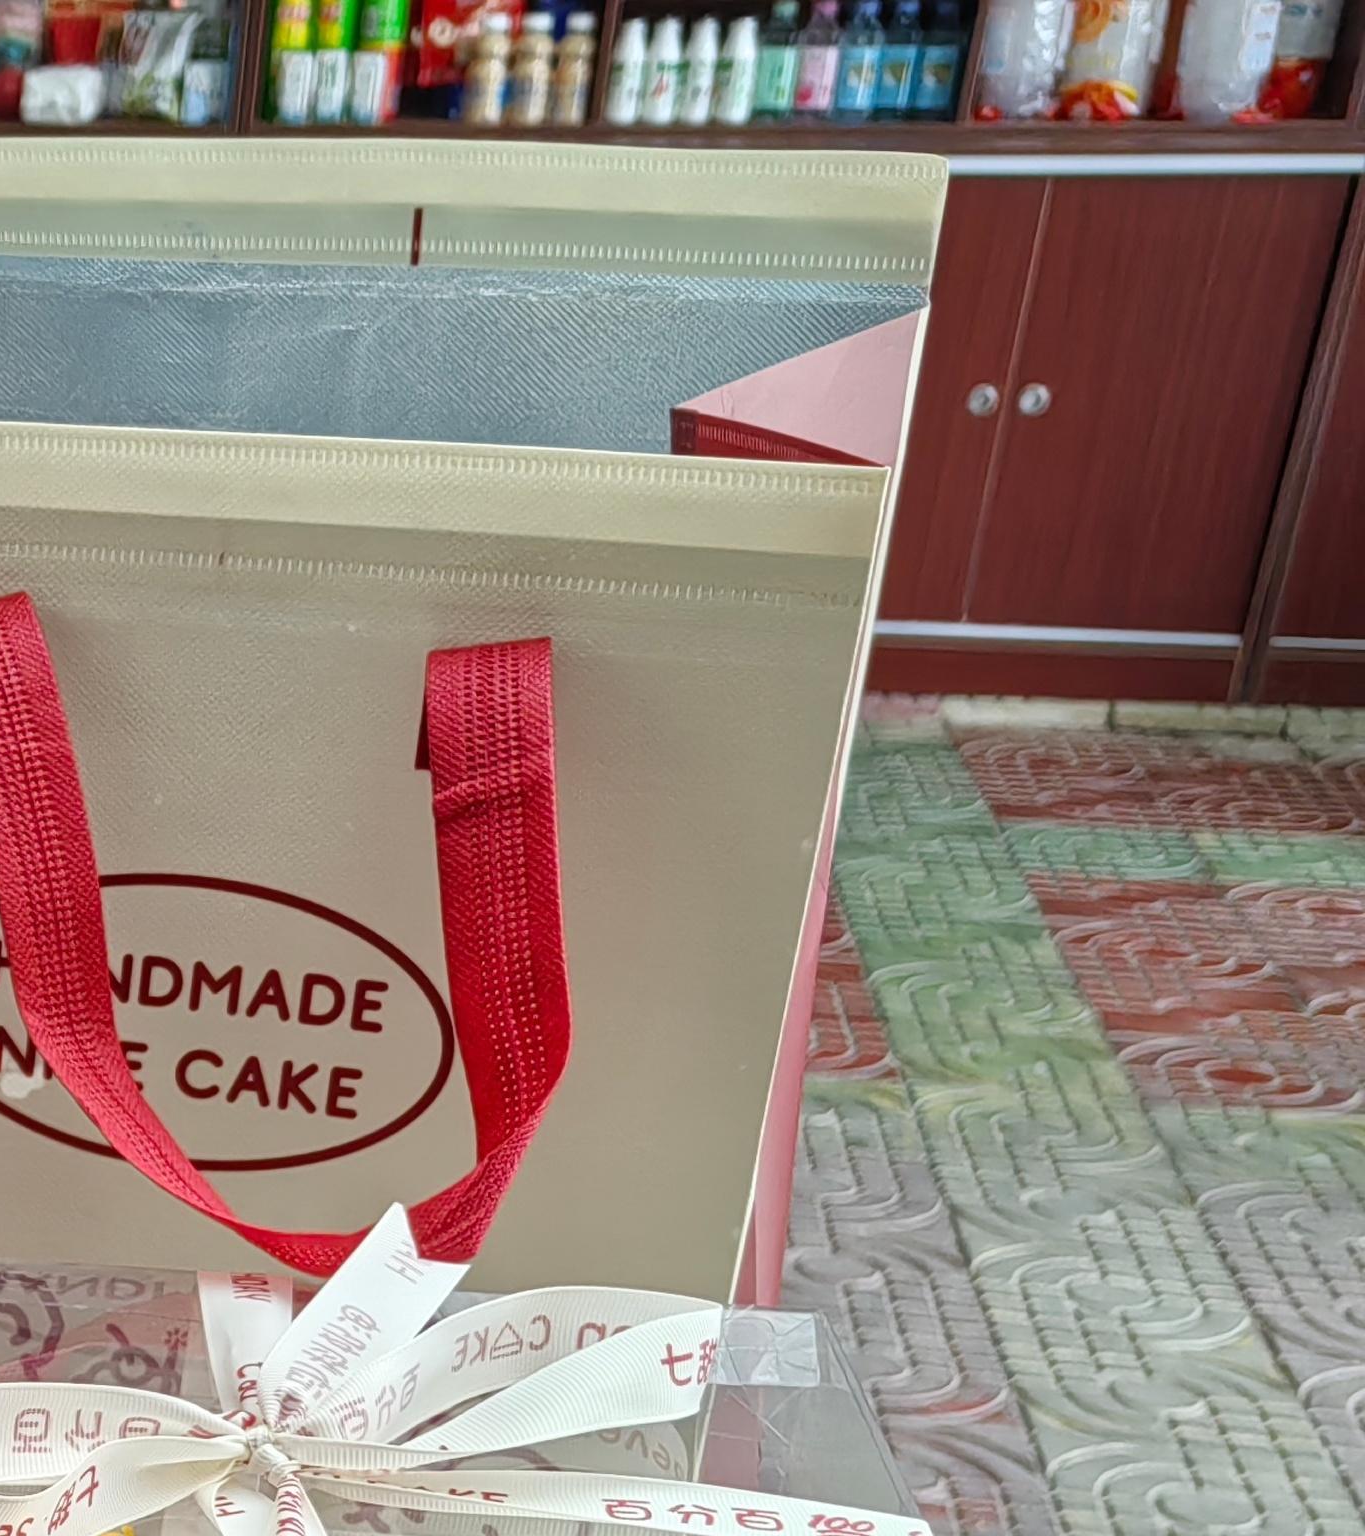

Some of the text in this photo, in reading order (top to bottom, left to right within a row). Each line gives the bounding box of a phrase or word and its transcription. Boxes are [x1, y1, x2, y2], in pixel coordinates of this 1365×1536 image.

[174, 1049, 364, 1120] CAKE
[601, 1498, 784, 1532] 百分百
